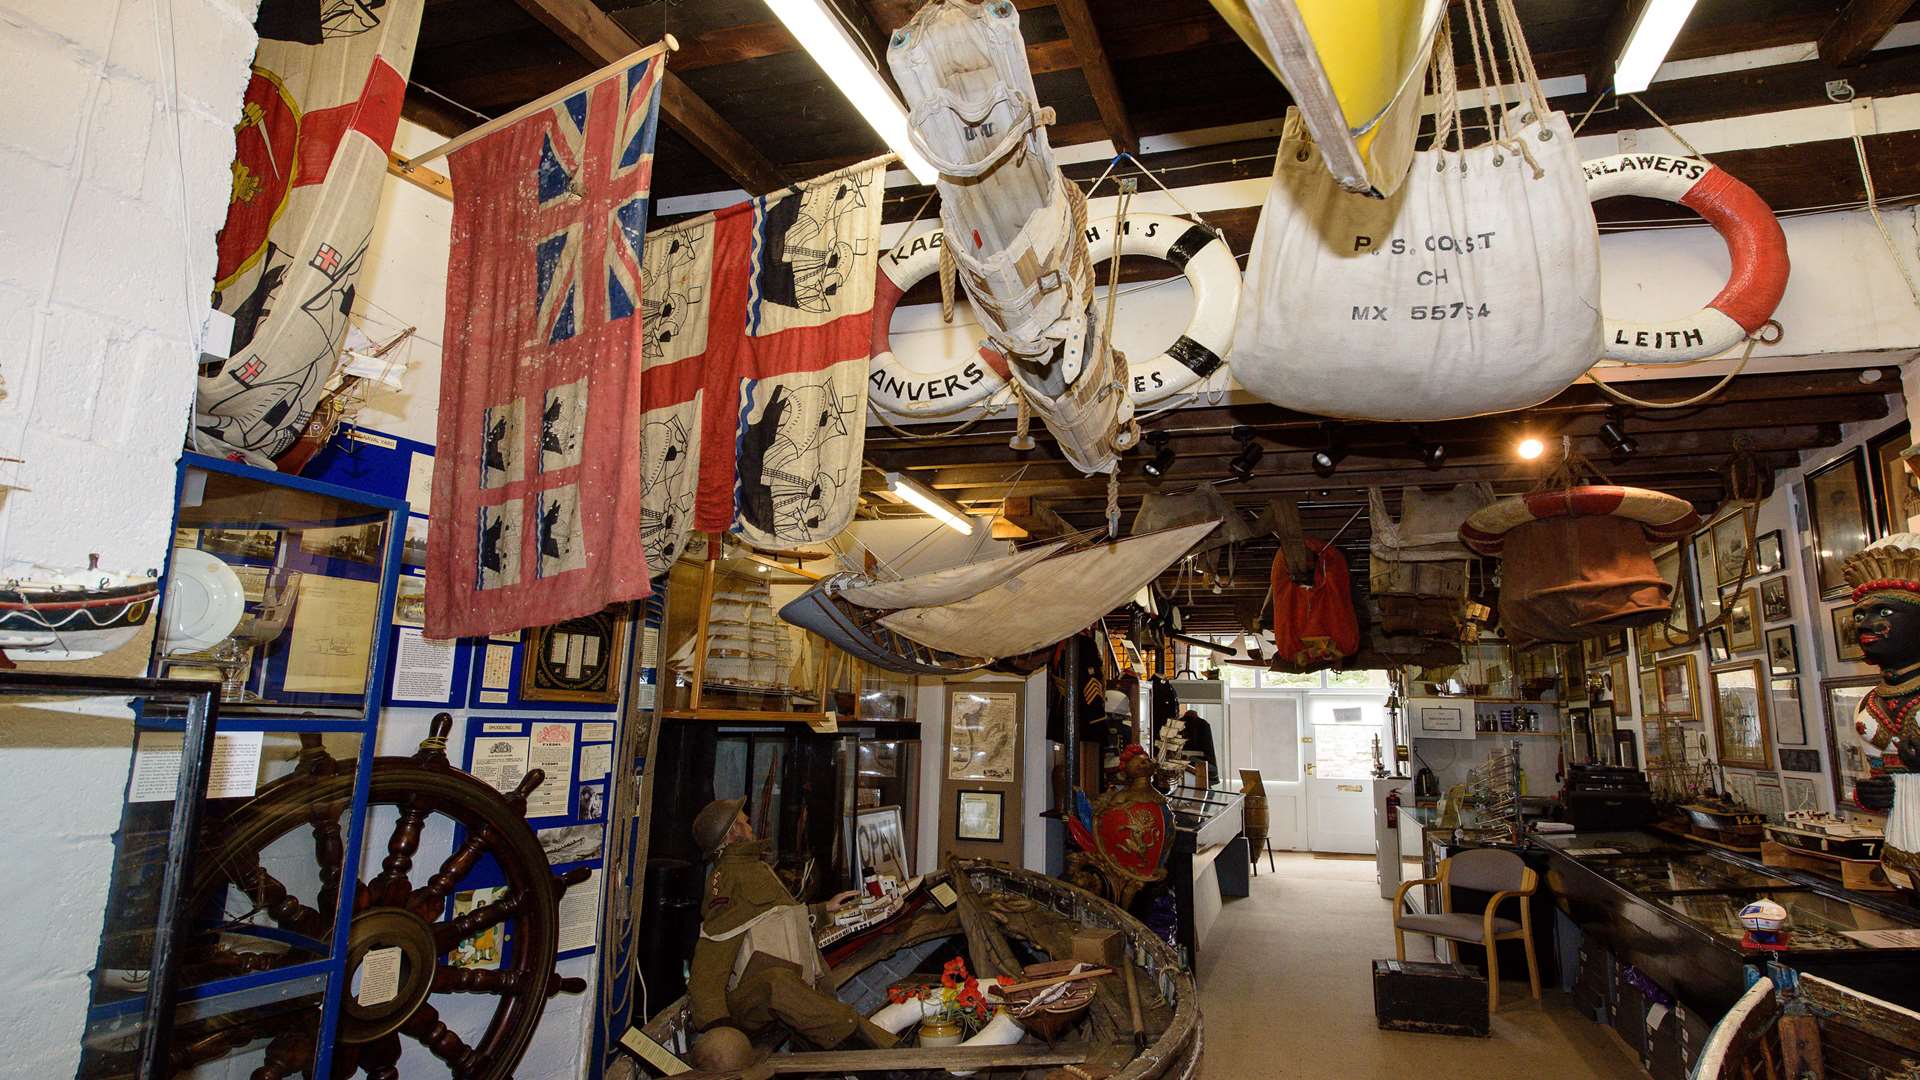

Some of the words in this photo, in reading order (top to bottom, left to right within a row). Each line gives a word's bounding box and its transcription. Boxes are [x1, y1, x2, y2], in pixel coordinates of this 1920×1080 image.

[1417, 269, 1448, 286] CH
[1352, 305, 1388, 321] MX
[1615, 329, 1703, 349] LEITH
[869, 362, 984, 401] ANVERS
[1736, 814, 1761, 826] 144
[1862, 842, 1876, 857] 7
